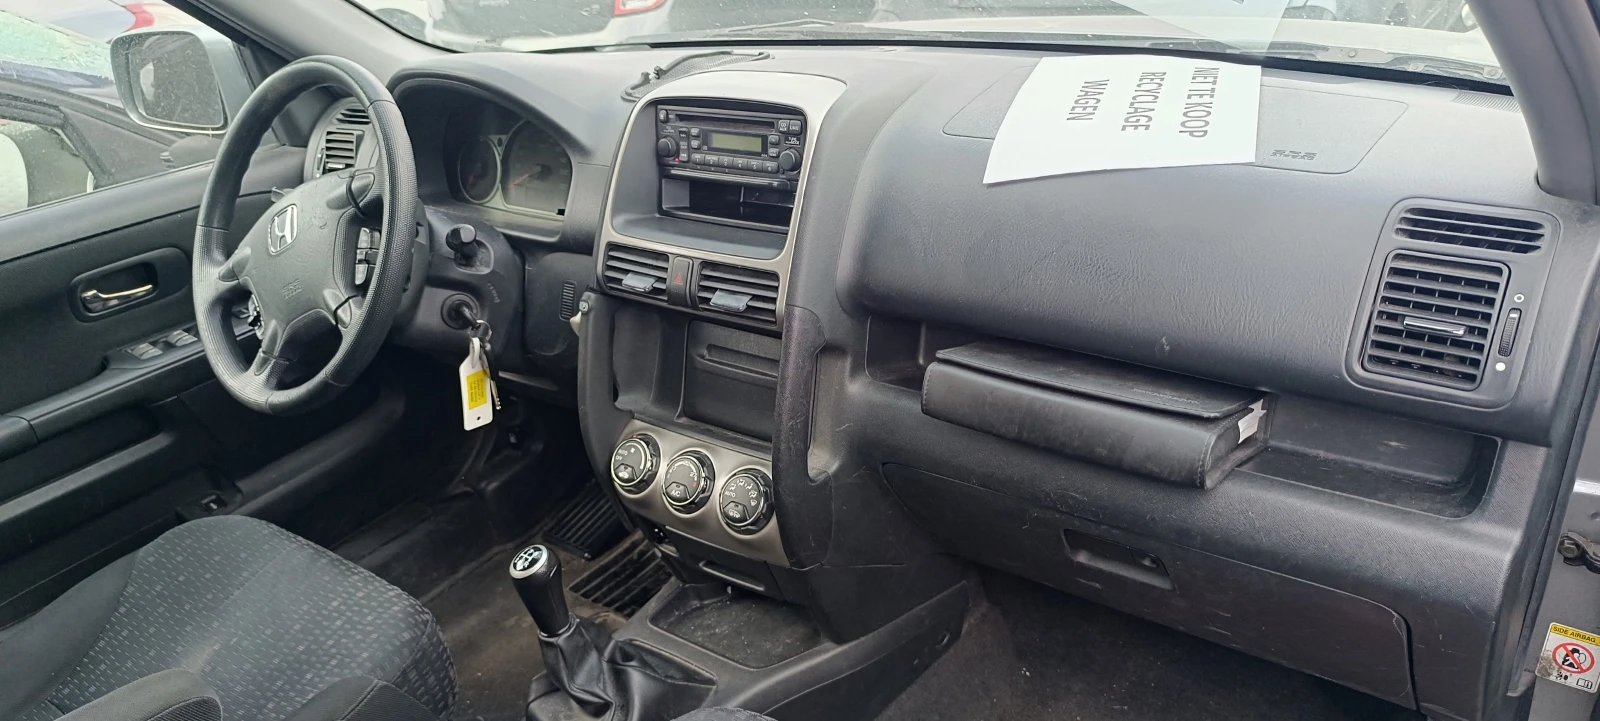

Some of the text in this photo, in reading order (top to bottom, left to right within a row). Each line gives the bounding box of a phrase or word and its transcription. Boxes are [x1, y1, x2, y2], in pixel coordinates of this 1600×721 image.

[1065, 79, 1110, 121] WAGEN
[1120, 71, 1167, 132] RECYCLAGE
[1178, 67, 1221, 138] NIET TE KOOP
[1553, 626, 1597, 643] SIDE AIRBAG
